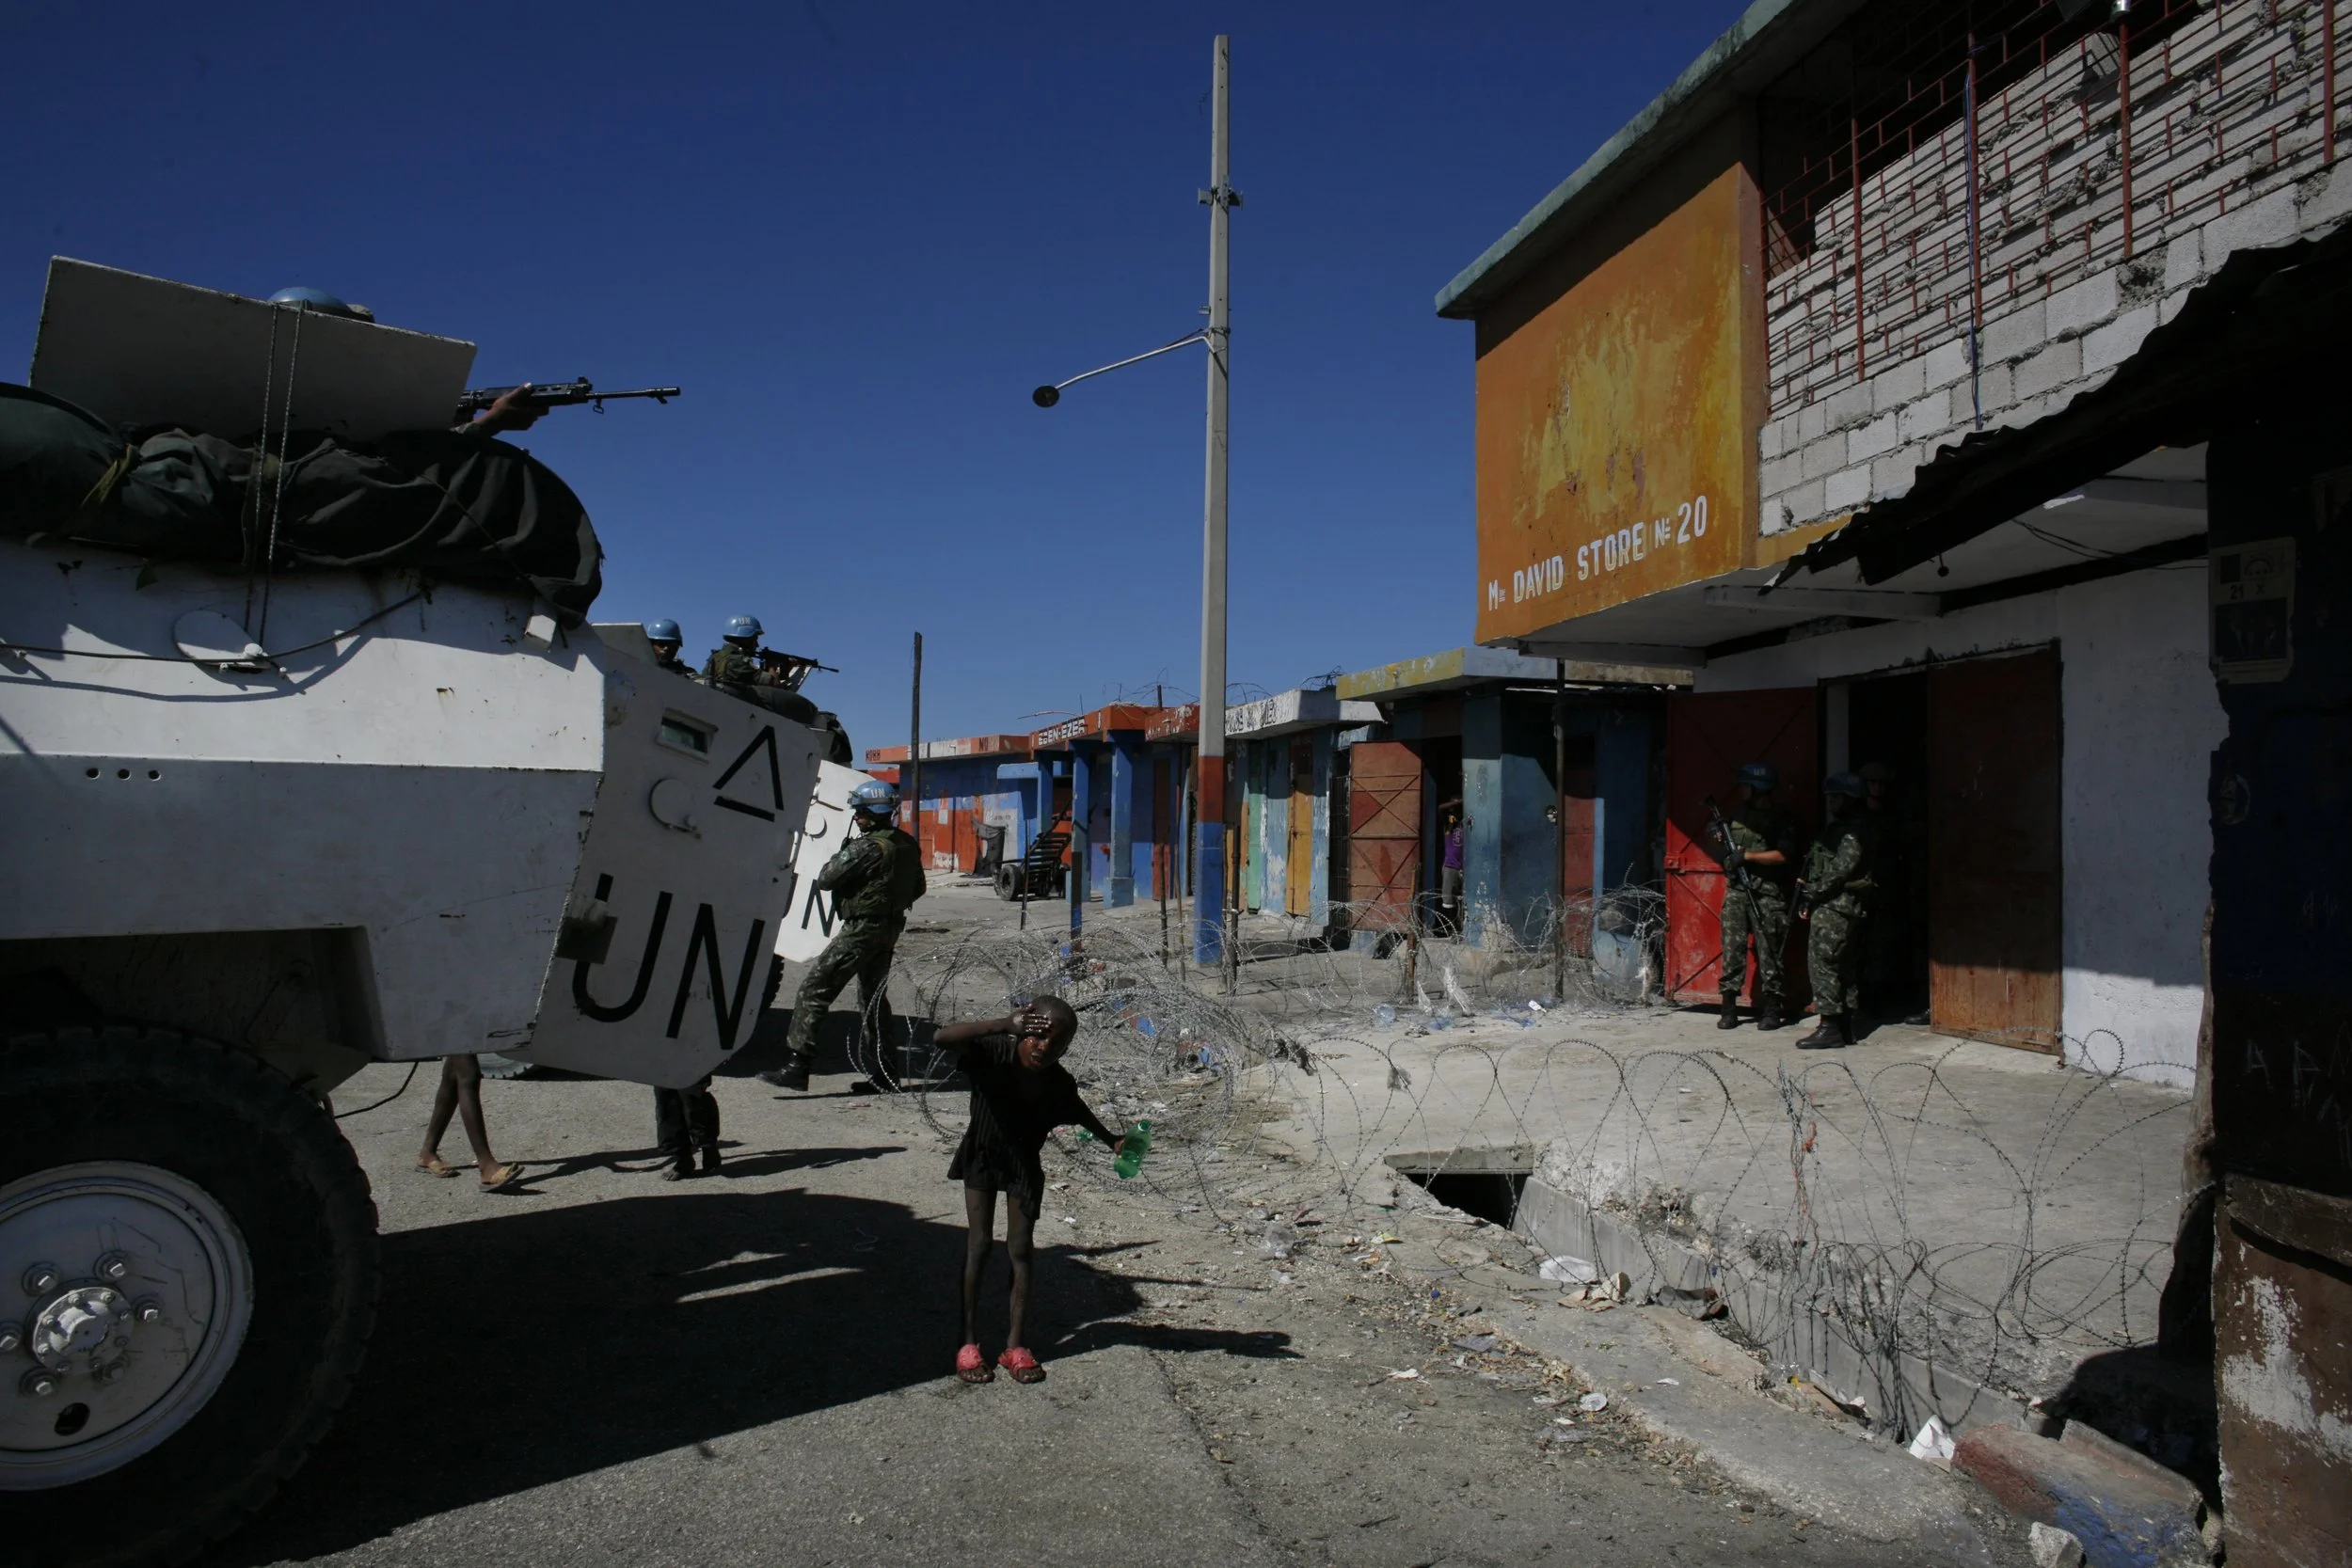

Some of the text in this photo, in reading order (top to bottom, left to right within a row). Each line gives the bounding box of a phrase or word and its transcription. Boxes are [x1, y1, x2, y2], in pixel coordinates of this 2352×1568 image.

[1513, 555, 1564, 604] DAVID
[1577, 521, 1645, 581] STORE
[1677, 495, 1708, 545] 20
[870, 787, 886, 799] UN
[572, 872, 765, 1051] UN
